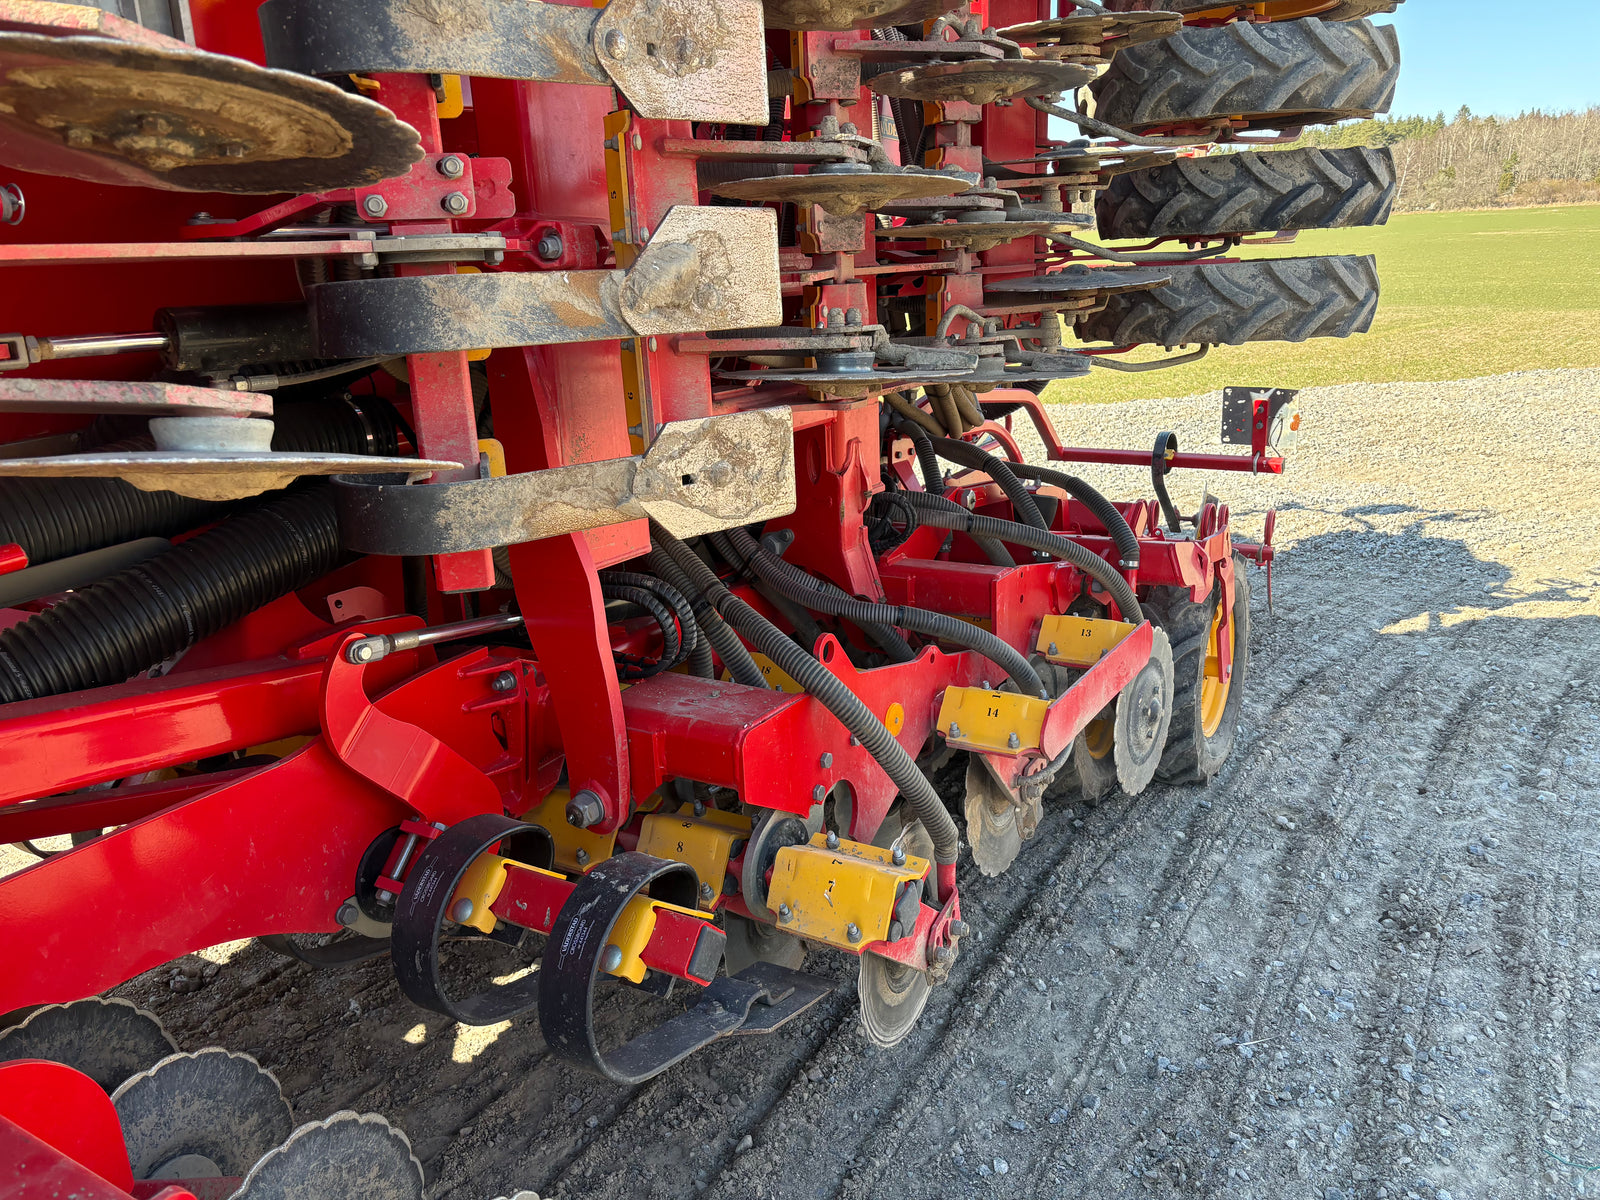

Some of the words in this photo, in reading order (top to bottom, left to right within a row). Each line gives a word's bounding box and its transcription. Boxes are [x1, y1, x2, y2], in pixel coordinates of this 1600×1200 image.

[610, 190, 617, 199] 5
[1081, 628, 1092, 637] 13
[761, 665, 771, 675] 18
[987, 707, 999, 718] 14
[676, 841, 684, 853] 8
[828, 880, 836, 893] 7
